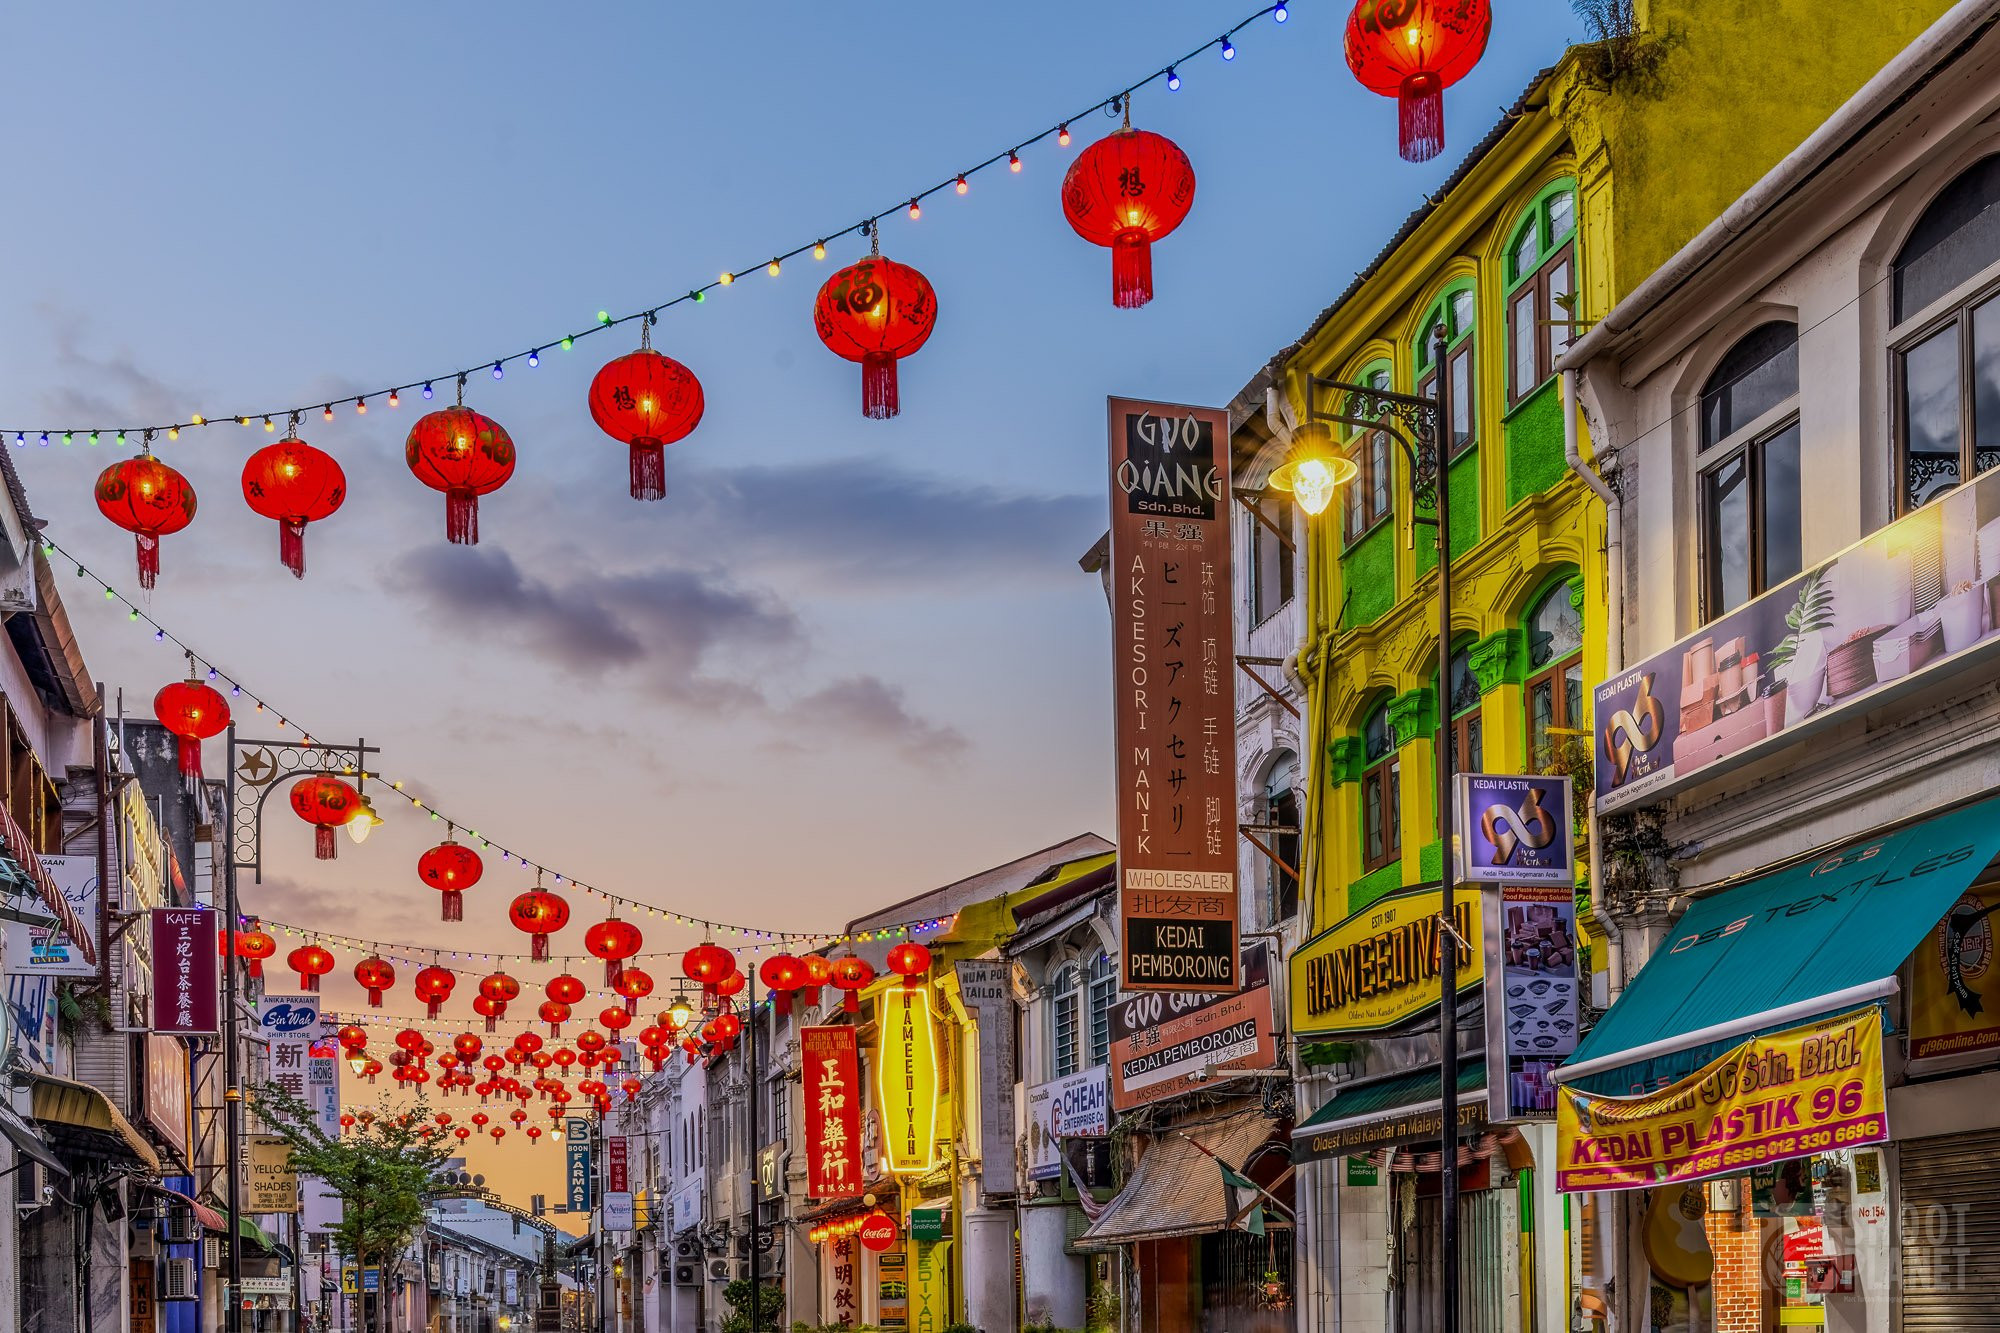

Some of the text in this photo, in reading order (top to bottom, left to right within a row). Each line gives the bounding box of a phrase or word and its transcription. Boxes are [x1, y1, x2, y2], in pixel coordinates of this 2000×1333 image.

[1138, 501, 1205, 515] Sdn.Bhd.
[1143, 540, 1203, 552] 有限公司
[1598, 670, 1643, 703] KEDAI PLASTIK
[1131, 554, 1151, 855] AKSESORI MANIK
[1203, 716, 1219, 775] 手链
[1473, 779, 1530, 791] KEDAI PLASTIK
[1128, 871, 1230, 890] WHOLESALER
[1516, 871, 1545, 879] Kegemaran
[1132, 893, 1225, 917] 批发商
[1519, 894, 1548, 902] Packaging
[1548, 894, 1573, 902] Solution
[165, 913, 202, 925] KAFE
[1156, 925, 1204, 949] KEDAI
[990, 968, 1008, 981] POE
[1131, 953, 1230, 979] PEMBORONG
[965, 986, 1003, 999] TAILOR
[267, 1012, 312, 1025] Sin Wah
[1124, 993, 1163, 1029] GUO
[1195, 1000, 1246, 1026] Sdn.Bhd.
[805, 1040, 853, 1050] MEDICAL HALL
[808, 1031, 831, 1042] CHENG
[1123, 1021, 1255, 1078] KEDAI PEMBORONG
[1204, 1041, 1256, 1065] 批发商
[313, 1067, 332, 1080] HONG
[1701, 1027, 1861, 1104] 96 Sdn. Bhd.
[1029, 1088, 1050, 1103] Crocodile
[1063, 1081, 1105, 1116] CHEAH
[1136, 1080, 1177, 1101] AKSESORI
[818, 1058, 849, 1181] 正和藥行
[1064, 1112, 1096, 1131] ENTERPRISE
[1569, 1078, 1865, 1167] KEDAI PLASTIK 96
[1313, 1136, 1340, 1152] Oldest
[1342, 1131, 1361, 1144] Nasi
[1362, 1124, 1394, 1143] Kandar
[1397, 1122, 1406, 1136] in
[1695, 1154, 1721, 1172] 995
[1723, 1147, 1767, 1166] 6696
[1767, 1137, 1796, 1154] 012
[1798, 1131, 1832, 1150] 330
[1835, 1120, 1880, 1143] 6696
[254, 1182, 292, 1192] SHADES
[572, 1153, 585, 1210] FARMASI
[817, 1182, 855, 1193] 有限公司
